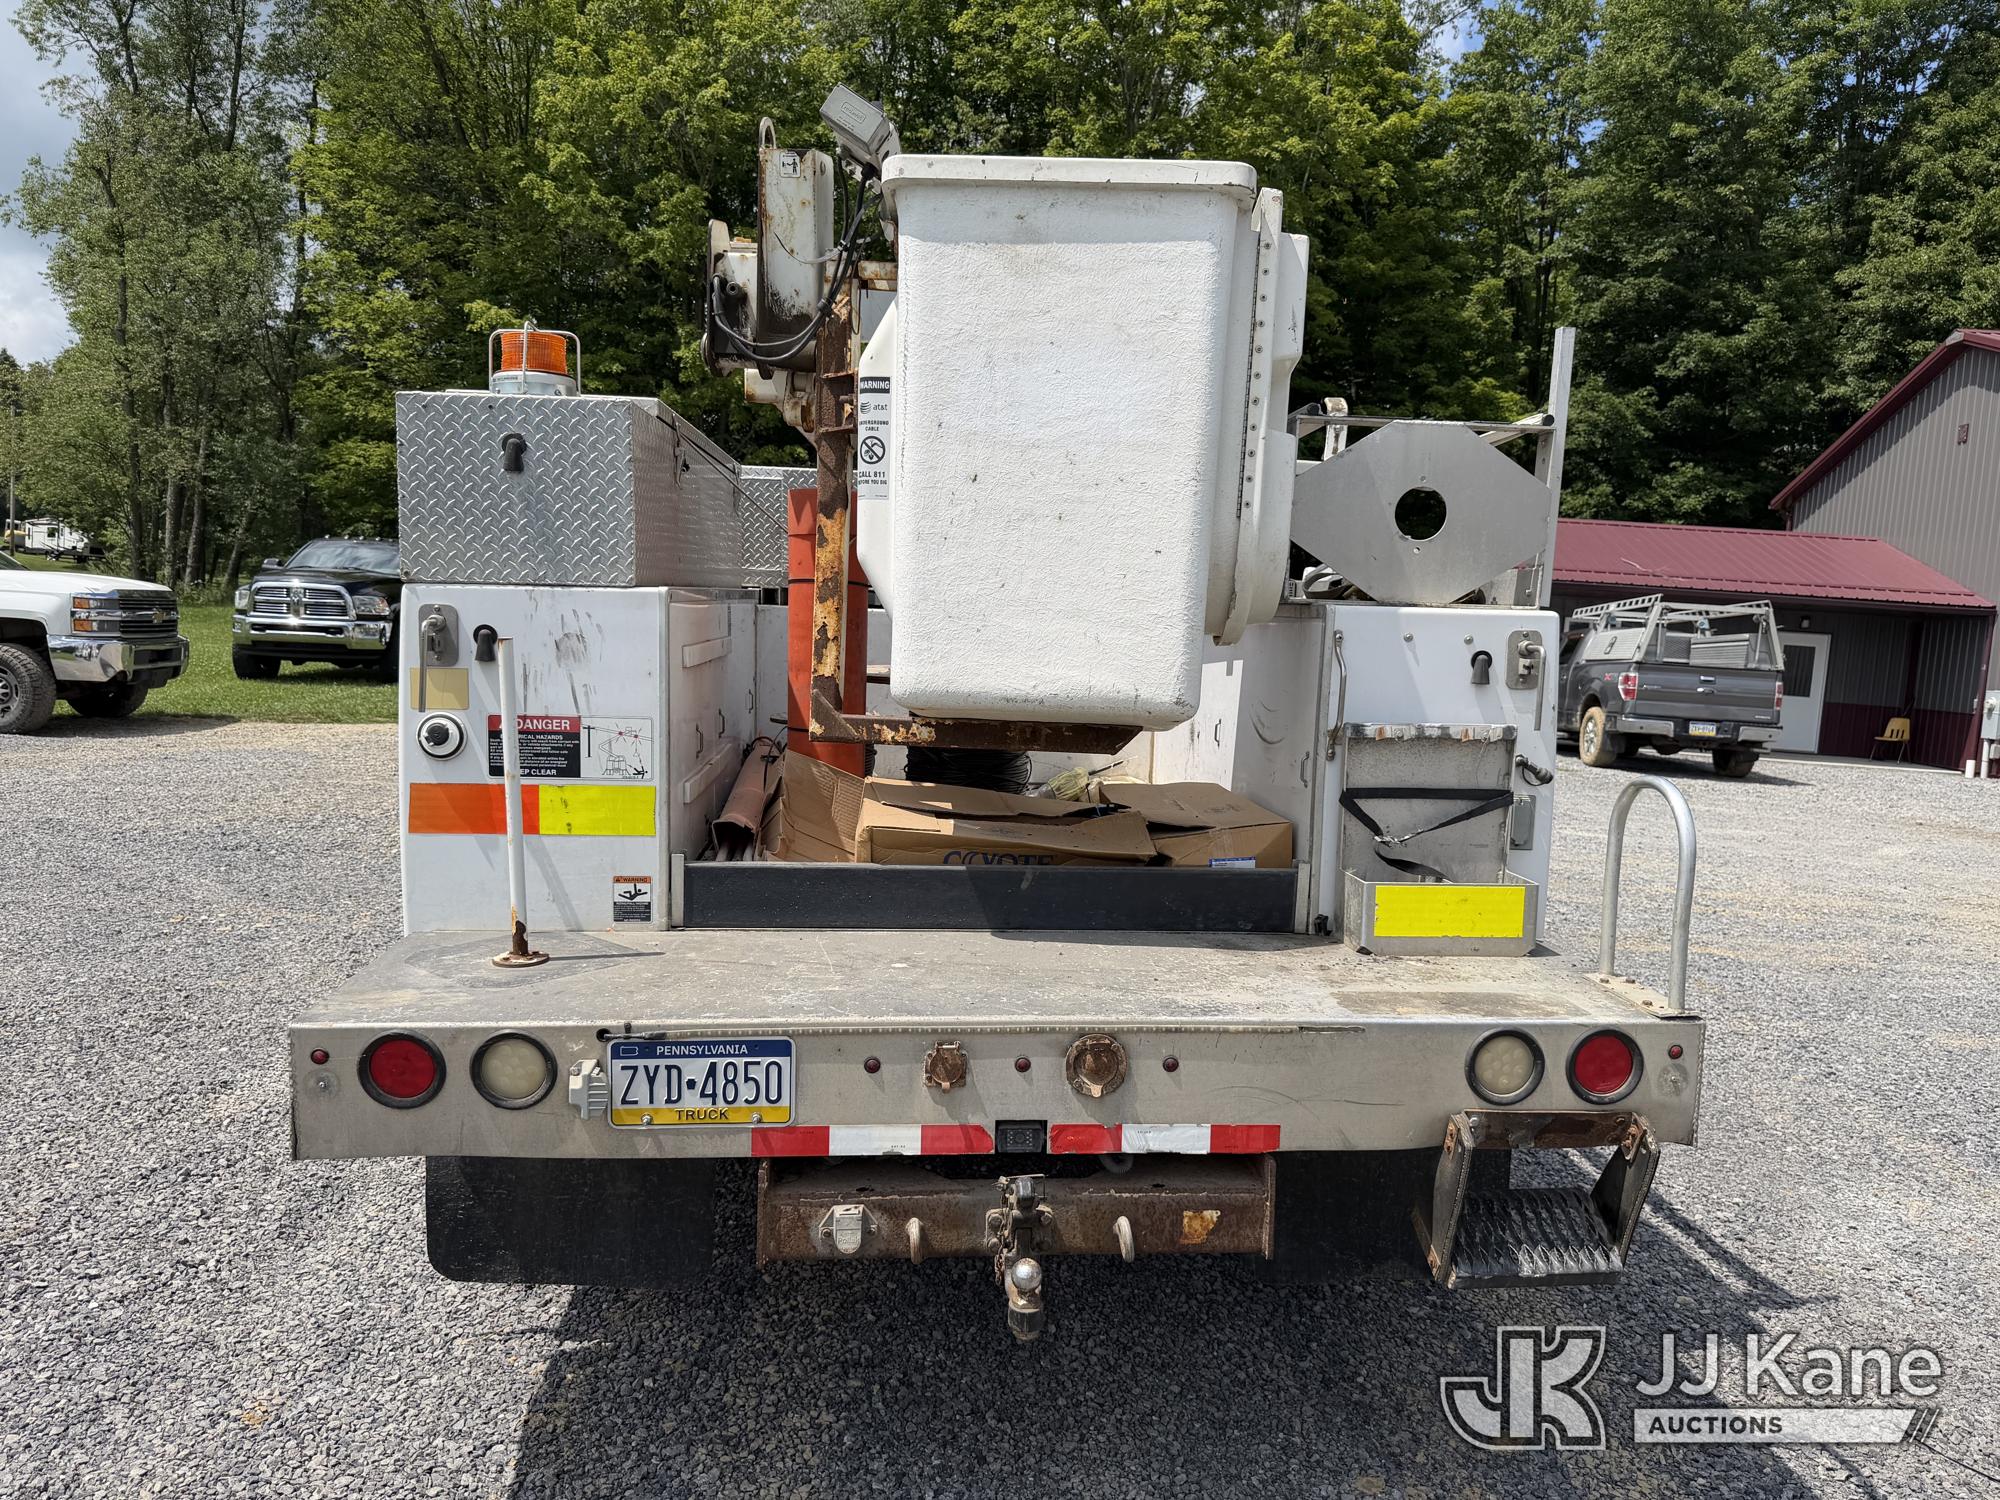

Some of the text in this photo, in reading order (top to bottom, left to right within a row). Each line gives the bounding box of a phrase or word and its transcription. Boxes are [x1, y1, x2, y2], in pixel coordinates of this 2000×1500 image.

[860, 380, 889, 389] WARNING
[516, 719, 570, 730] DANGER
[656, 1044, 748, 1056] PENNSYLVANIA
[675, 1109, 729, 1121] TRUCK
